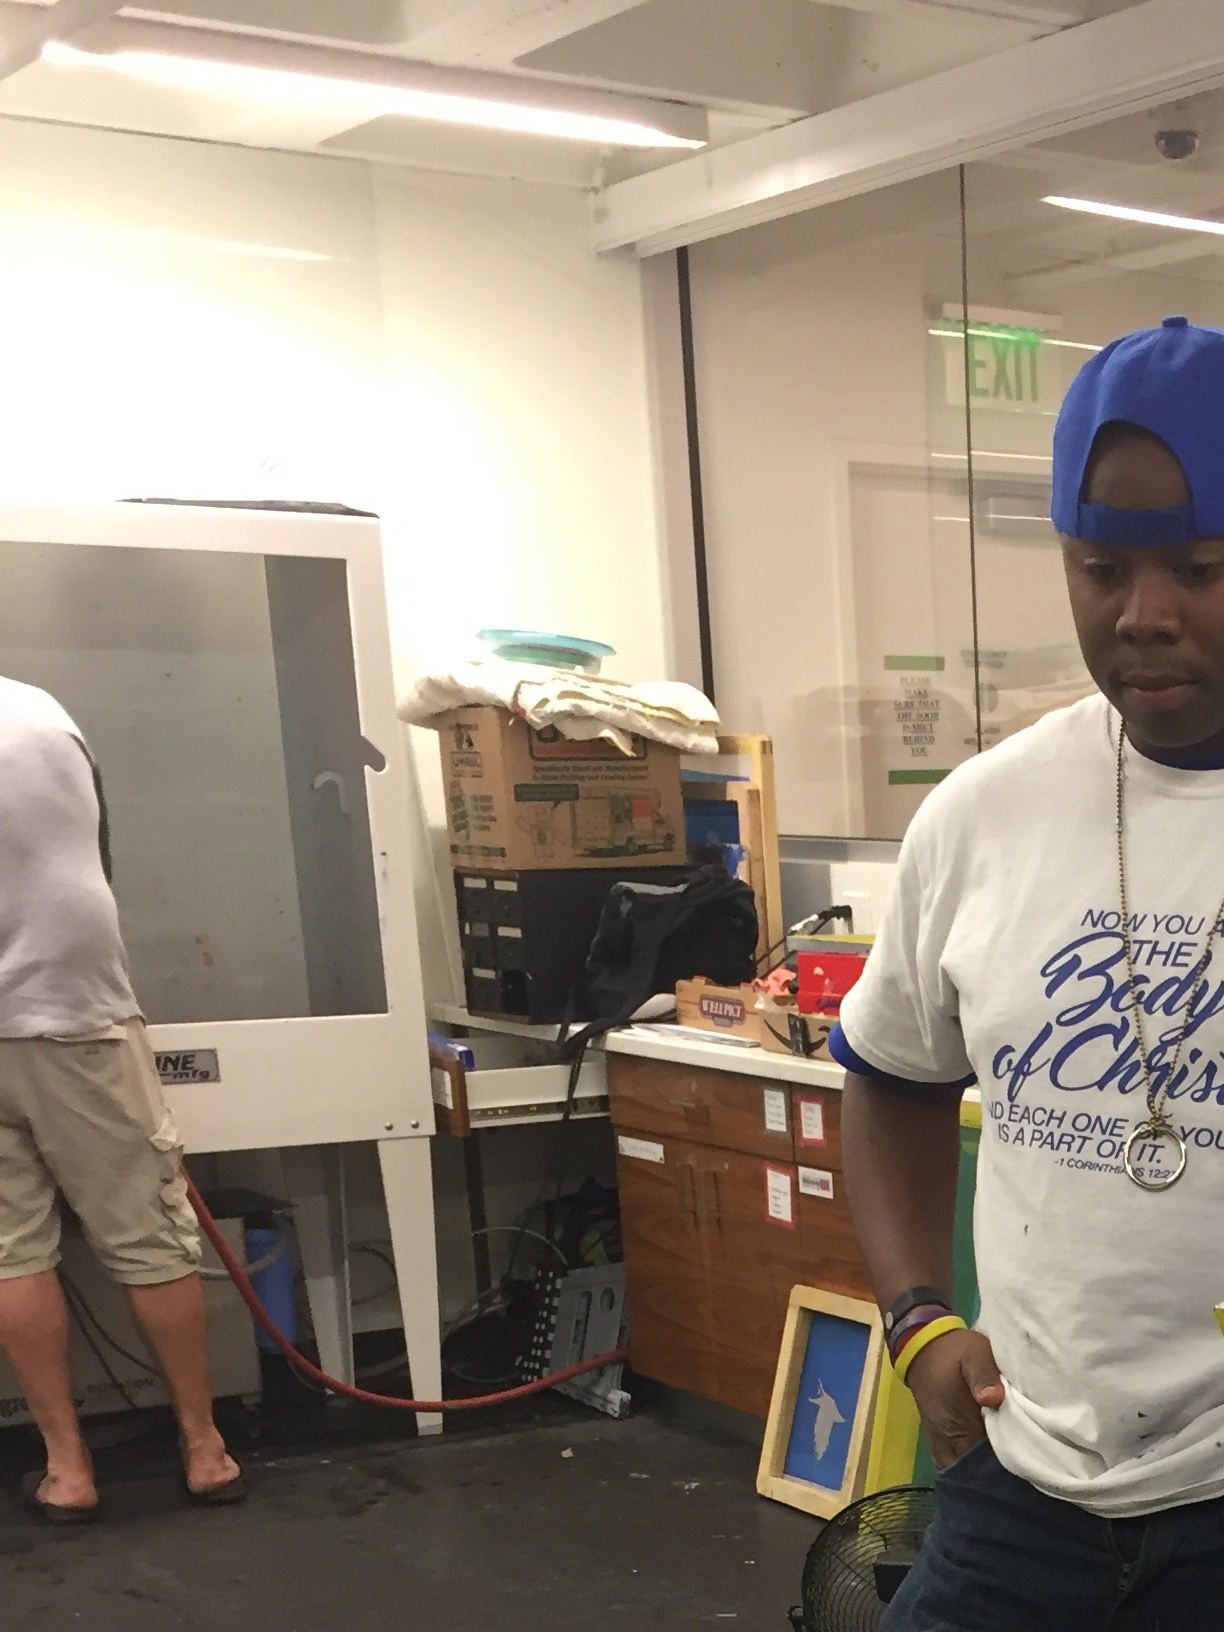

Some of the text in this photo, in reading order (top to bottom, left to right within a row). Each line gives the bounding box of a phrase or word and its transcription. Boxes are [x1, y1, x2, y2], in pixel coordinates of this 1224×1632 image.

[967, 333, 1041, 402] EXIT
[1080, 908, 1148, 933] NOW
[1152, 913, 1206, 936] YOU
[1131, 939, 1198, 968] THE
[992, 1021, 1051, 1103] of
[1007, 1103, 1067, 1129] EACH
[1071, 1112, 1130, 1138] ONE
[997, 1122, 1010, 1143] IS
[1012, 1126, 1025, 1146] A
[1028, 1128, 1094, 1154] PART
[1136, 1143, 1166, 1164] IT.
